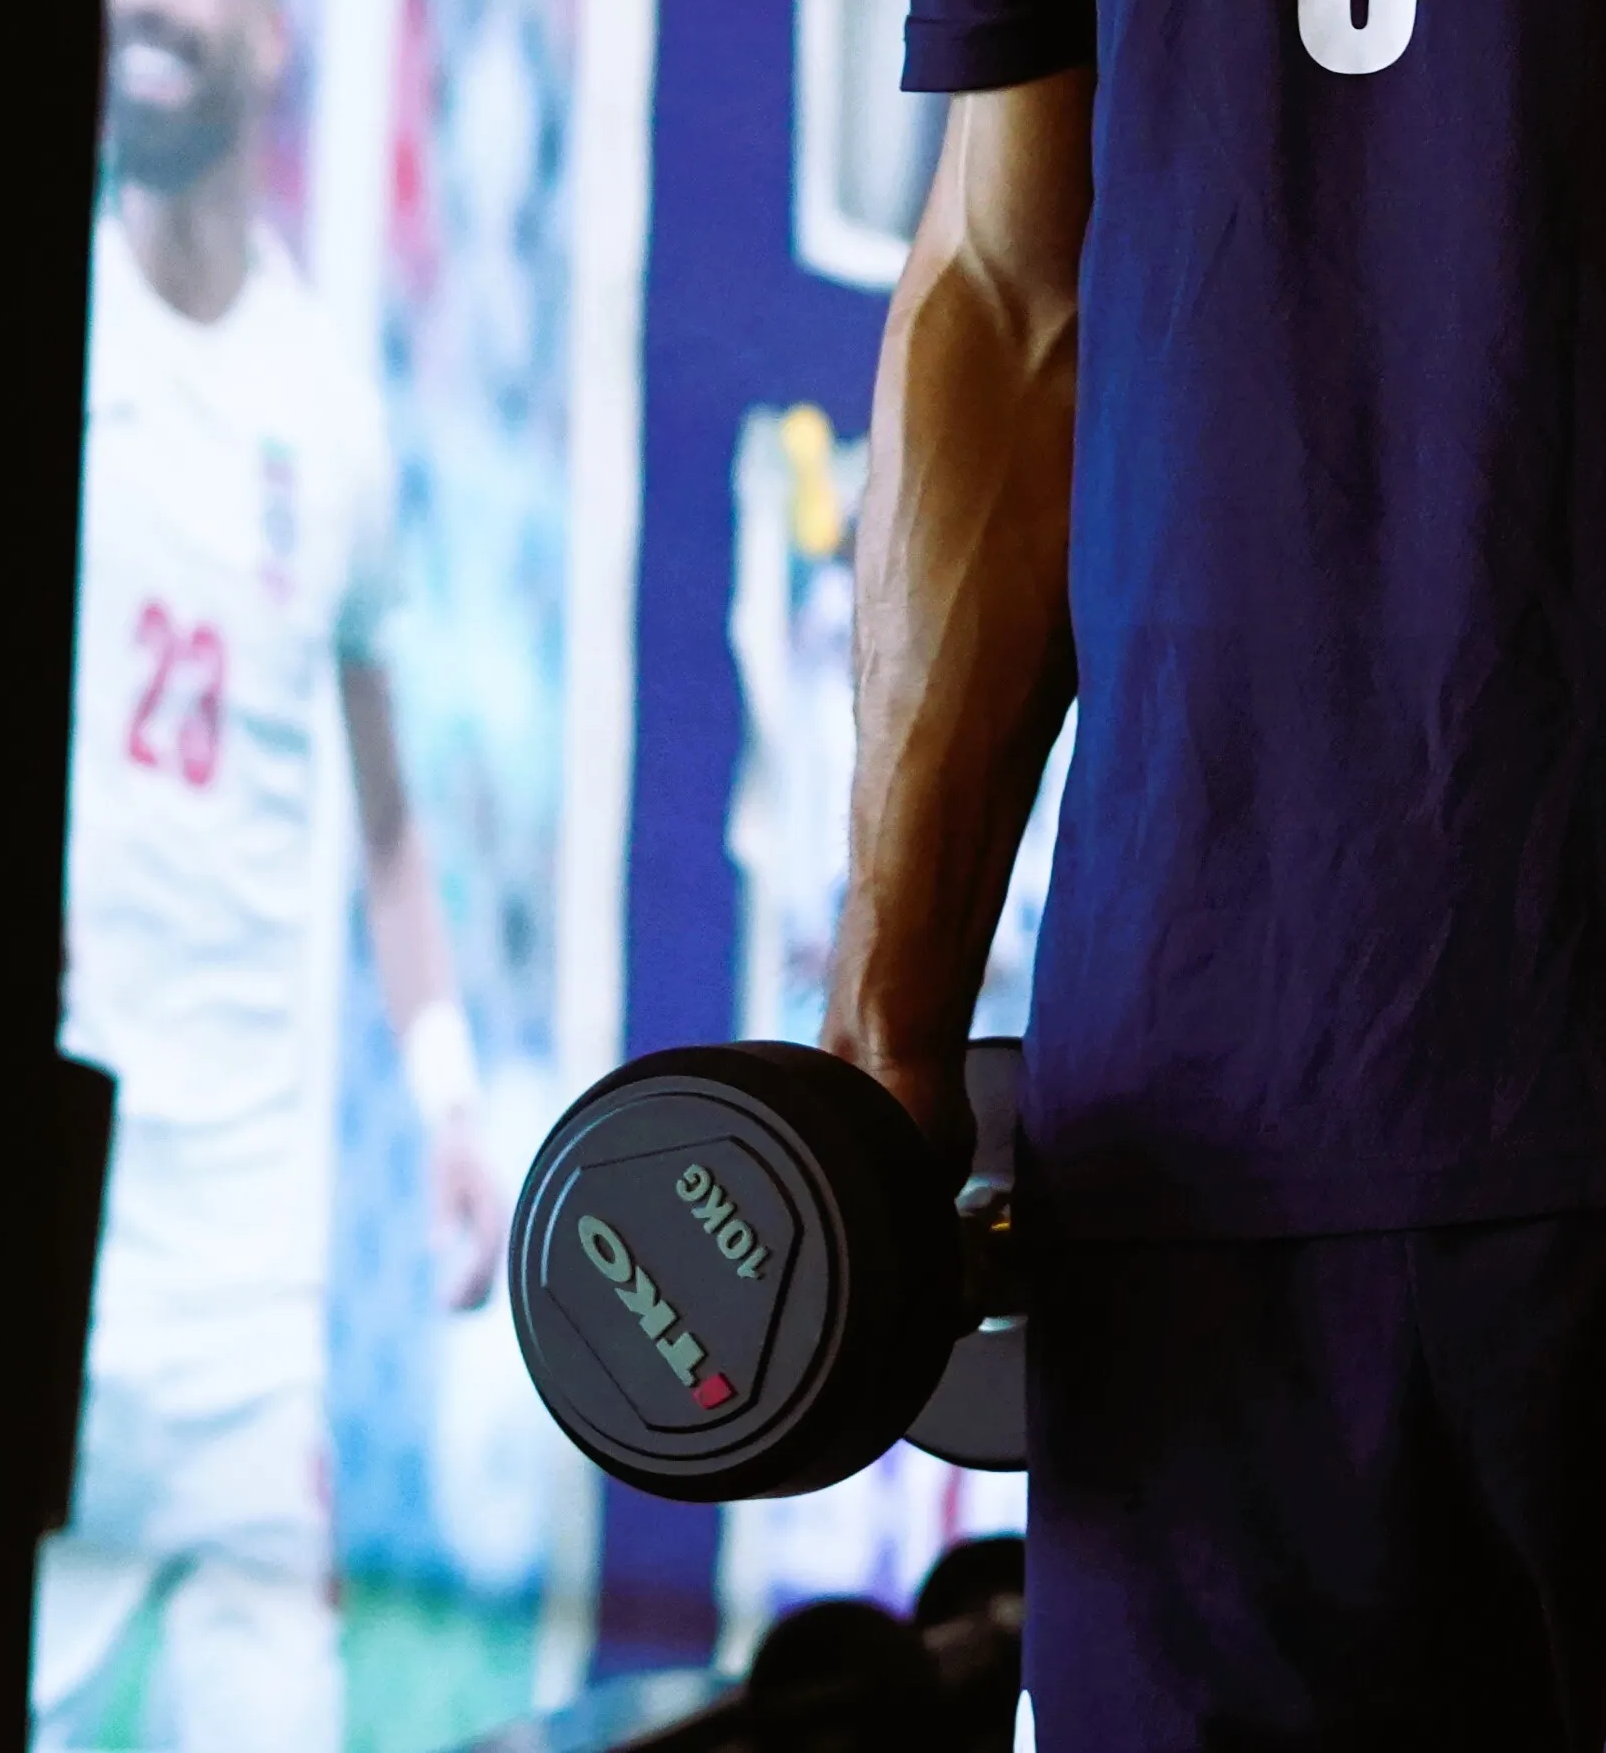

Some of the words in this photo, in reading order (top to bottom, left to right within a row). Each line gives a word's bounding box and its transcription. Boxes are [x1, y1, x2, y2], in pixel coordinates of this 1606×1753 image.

[126, 599, 227, 789] 23
[577, 1215, 707, 1389] TKO
[675, 1163, 773, 1281] 10KG
